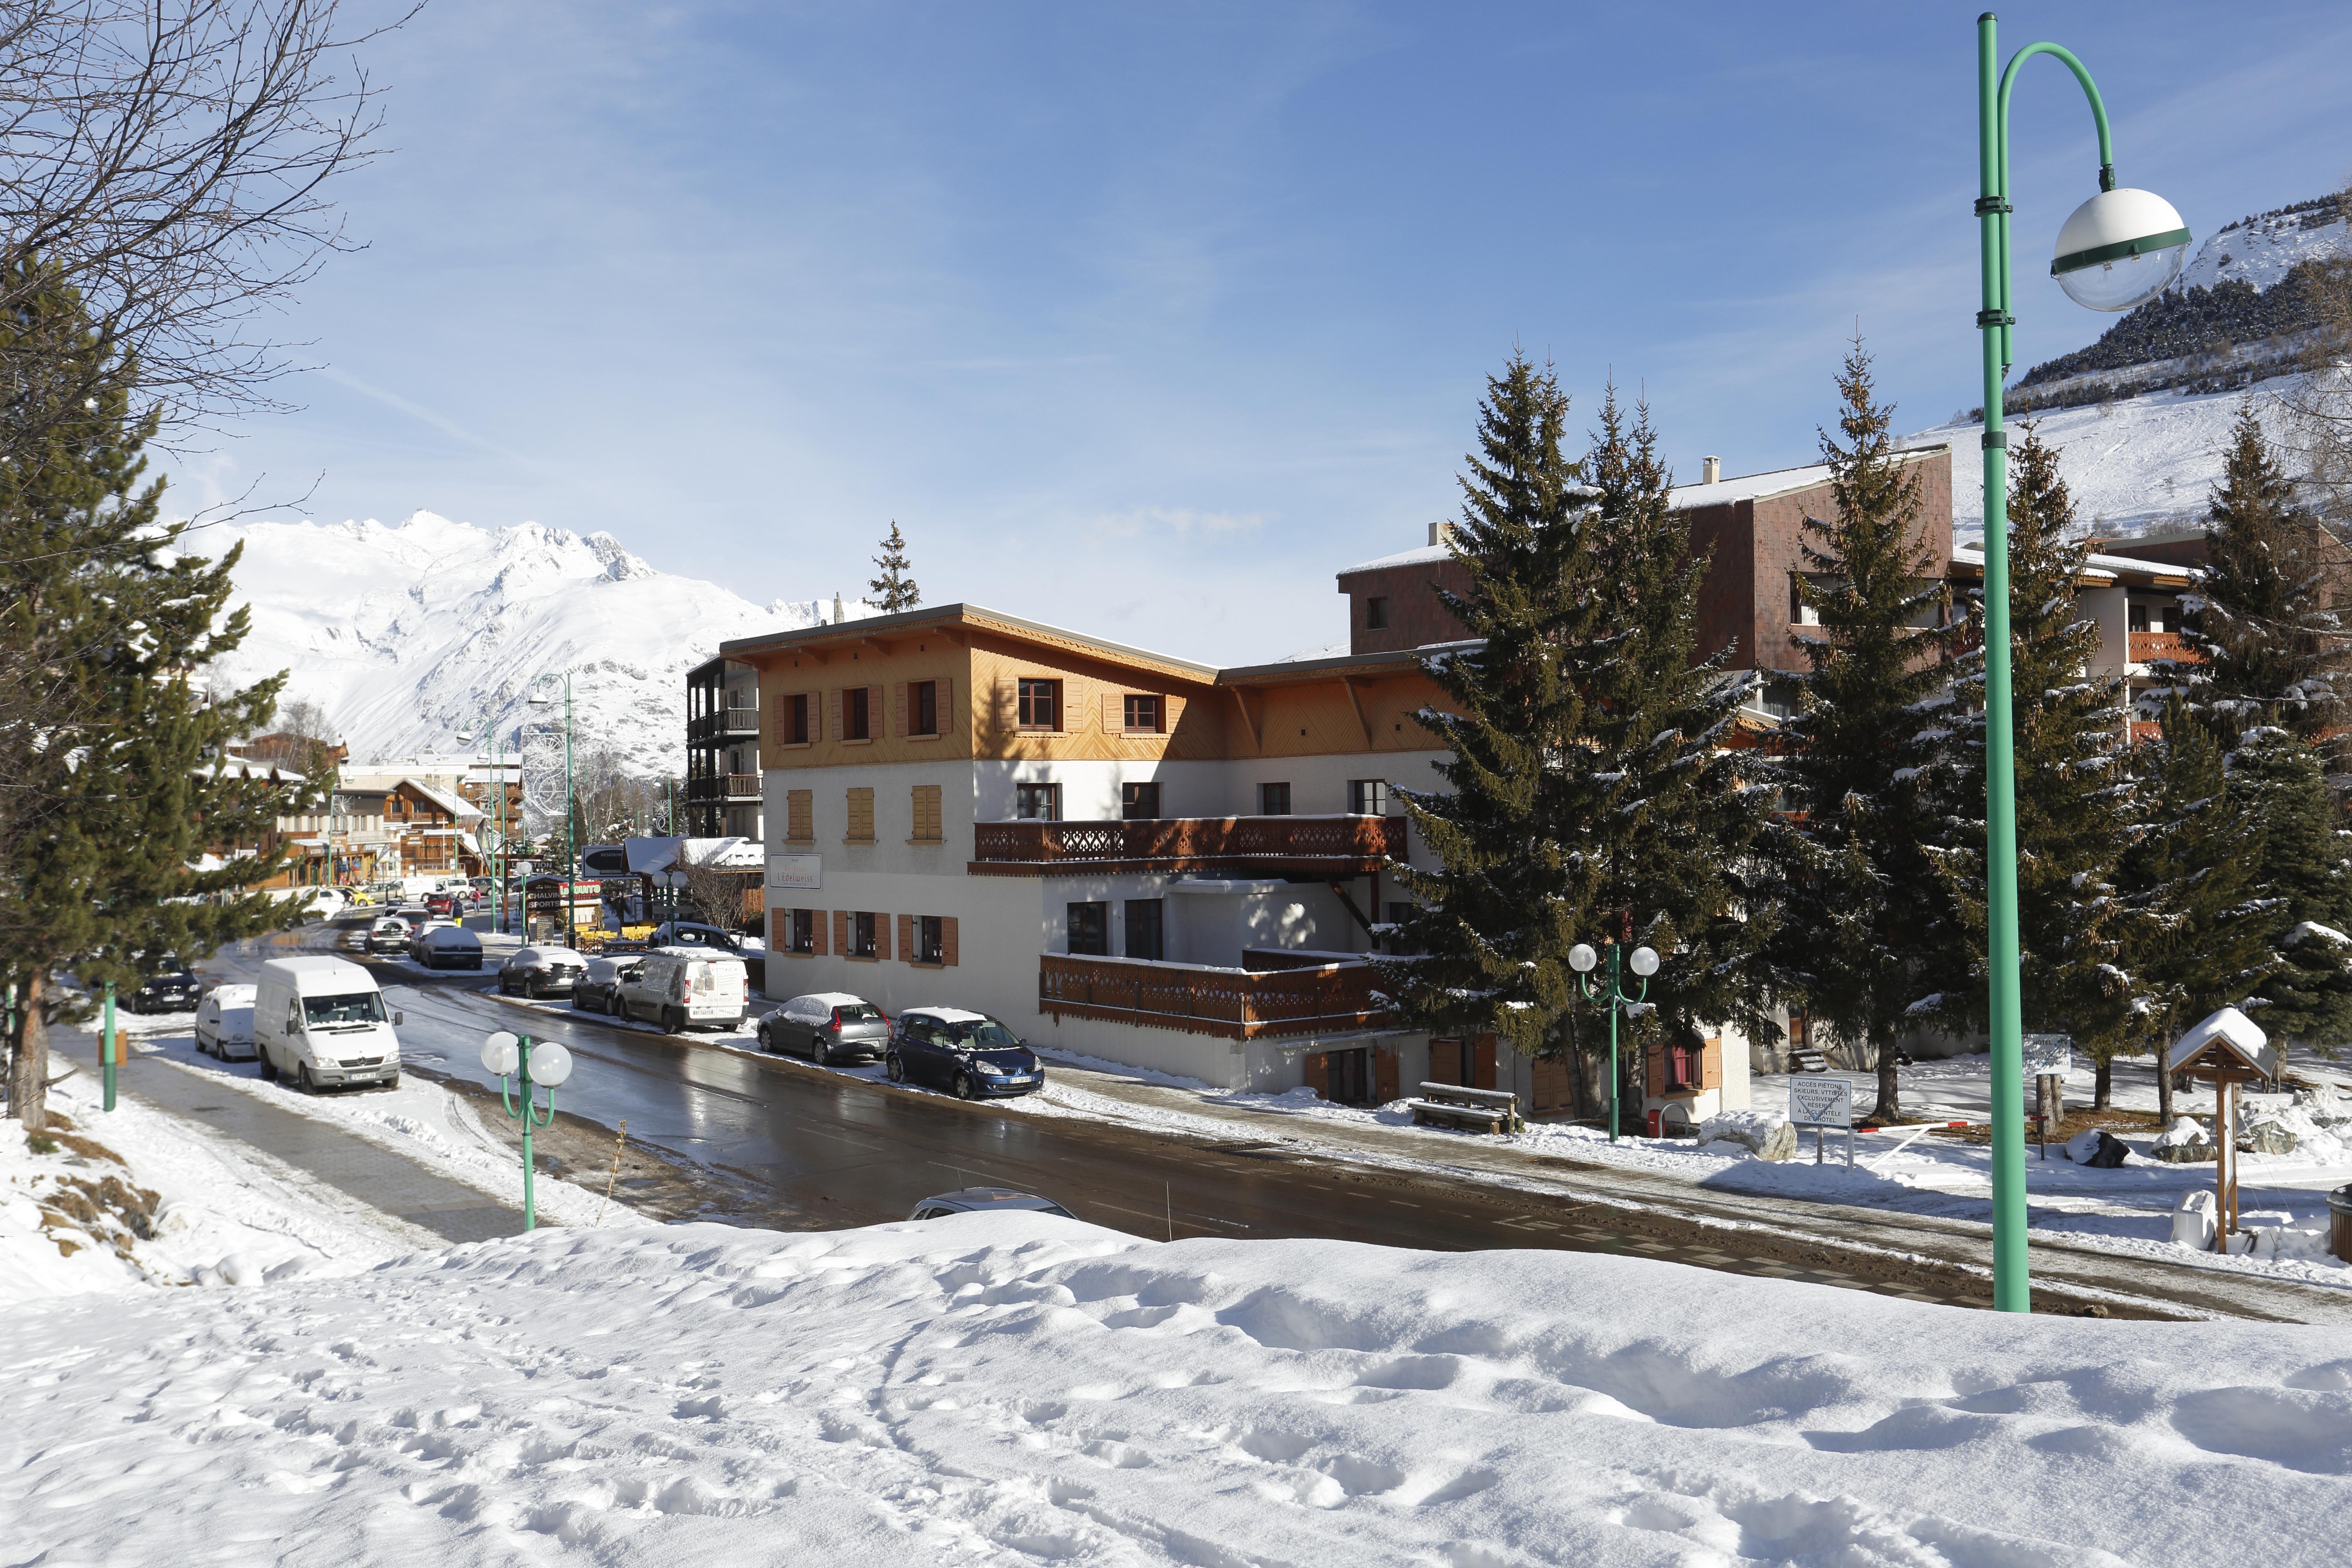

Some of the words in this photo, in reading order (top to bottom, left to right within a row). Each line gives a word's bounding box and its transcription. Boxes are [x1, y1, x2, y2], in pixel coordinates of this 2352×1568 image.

[778, 872, 813, 882] l'Edelweiss
[560, 885, 569, 895] La
[572, 884, 601, 894] ourra
[1797, 1095, 1844, 1103] EXCLUSIVEMENT
